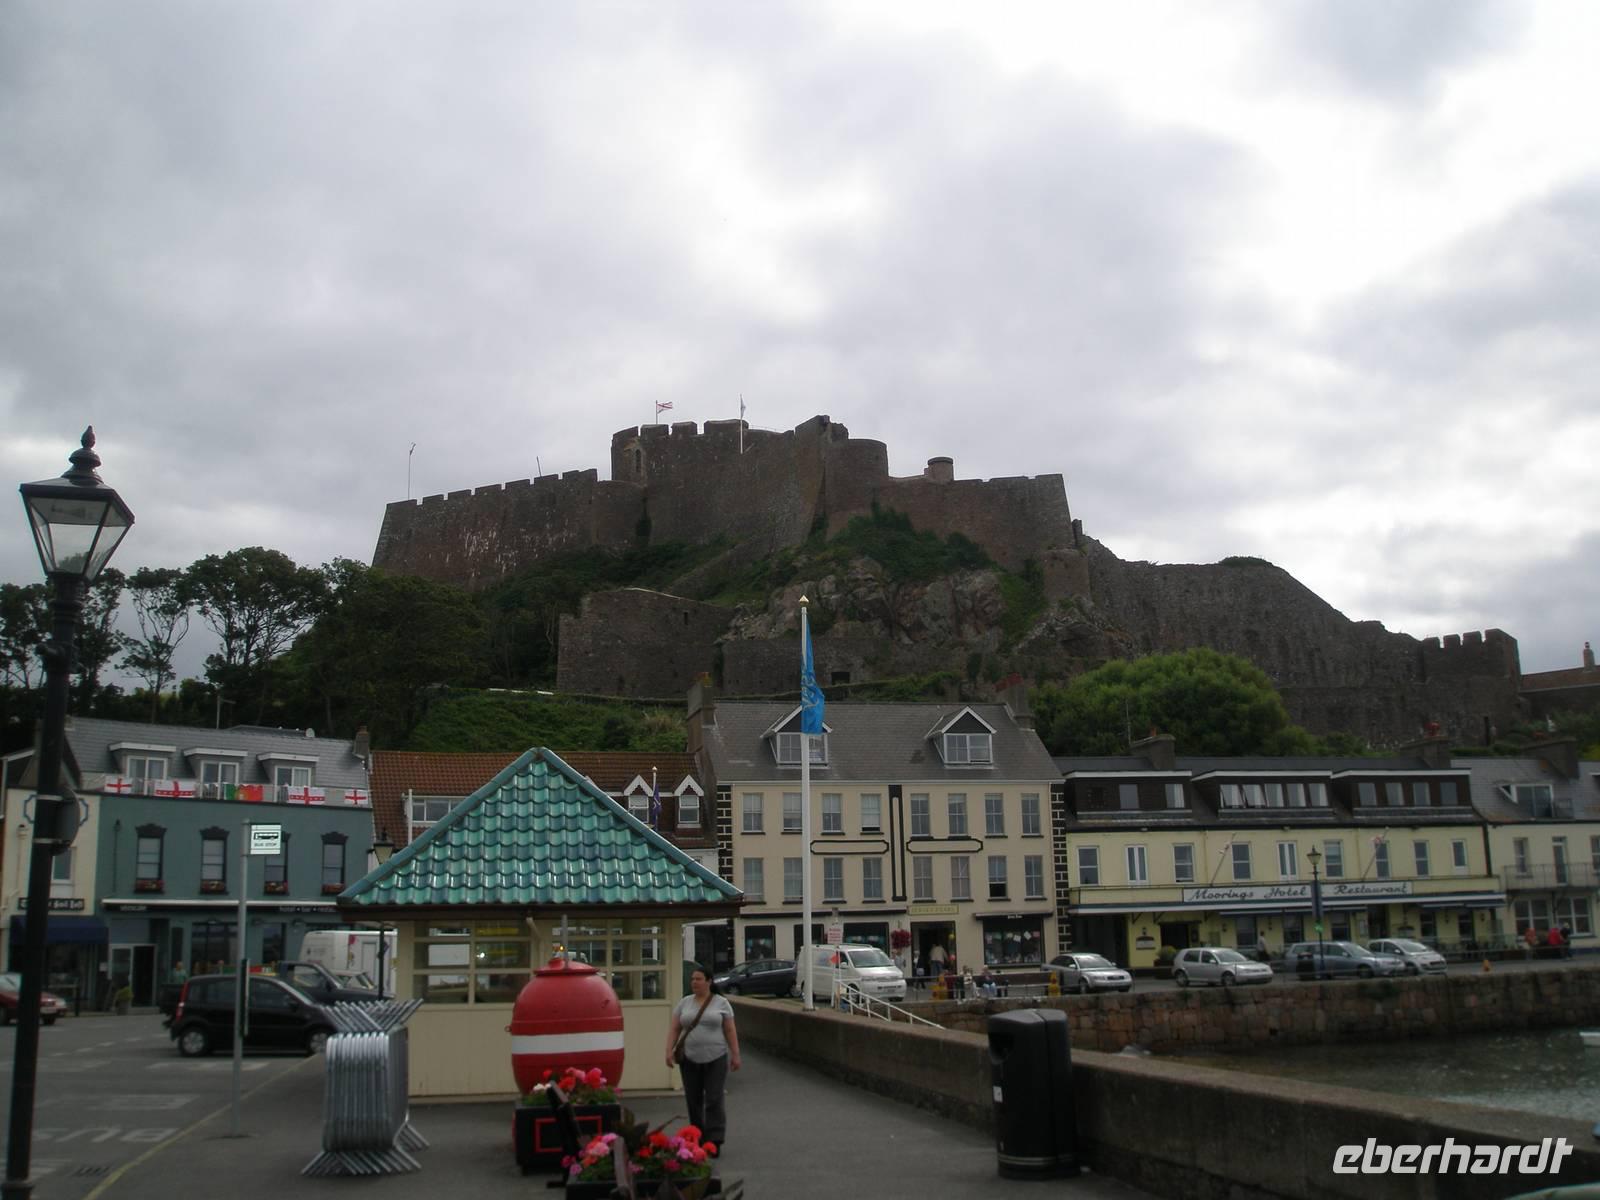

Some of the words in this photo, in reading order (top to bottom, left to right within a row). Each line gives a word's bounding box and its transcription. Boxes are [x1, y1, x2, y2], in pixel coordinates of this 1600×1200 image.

[1190, 889, 1254, 902] Moorings
[1263, 886, 1307, 898] Hotel
[1334, 884, 1408, 896] Restaurant
